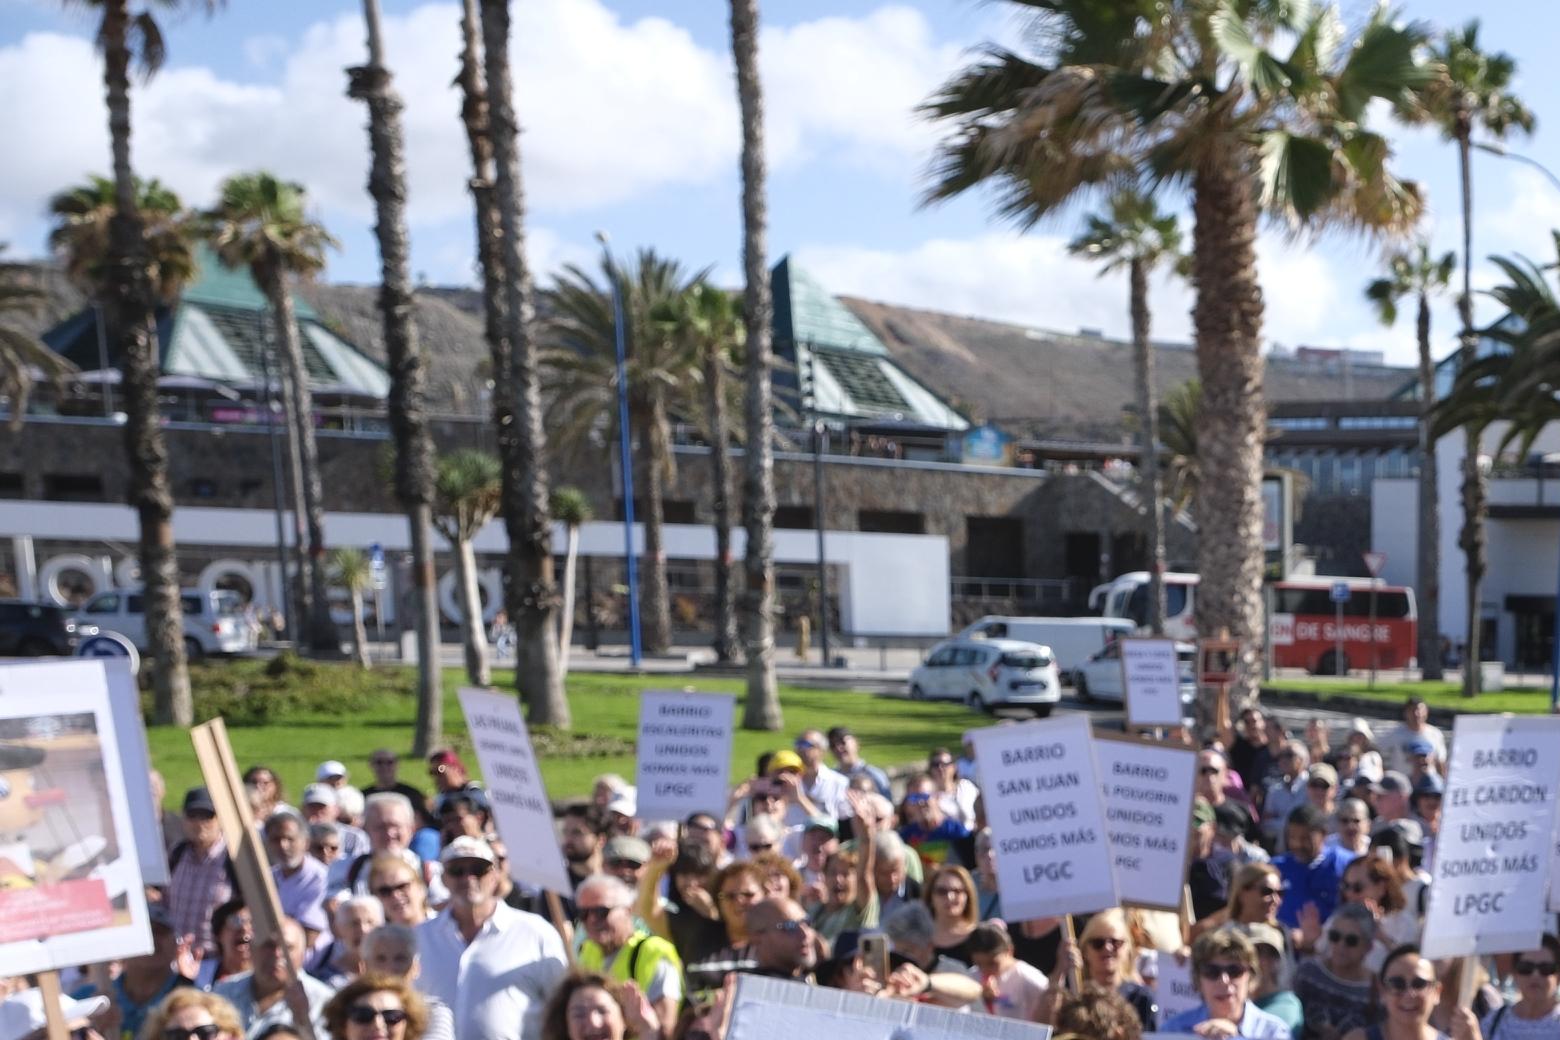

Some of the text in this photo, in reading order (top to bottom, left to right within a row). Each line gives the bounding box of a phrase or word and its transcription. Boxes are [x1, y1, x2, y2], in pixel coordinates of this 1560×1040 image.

[1001, 742, 1066, 767] BARRIO
[1472, 748, 1538, 769] BARRIO
[1112, 762, 1169, 782] BARRIO
[997, 771, 1080, 798] SAN JUAN
[1451, 788, 1470, 809] EL
[1009, 801, 1078, 826] UNIDOS
[1106, 807, 1165, 828] UNIDOS
[1108, 831, 1141, 849] MOS
[1460, 820, 1529, 842] UNIDOS
[999, 832, 1057, 856] SOMOS
[1022, 860, 1074, 885] LPGC
[1115, 855, 1143, 872] PGC
[1440, 855, 1498, 879] SOMOS
[1453, 892, 1506, 917] LPGC
